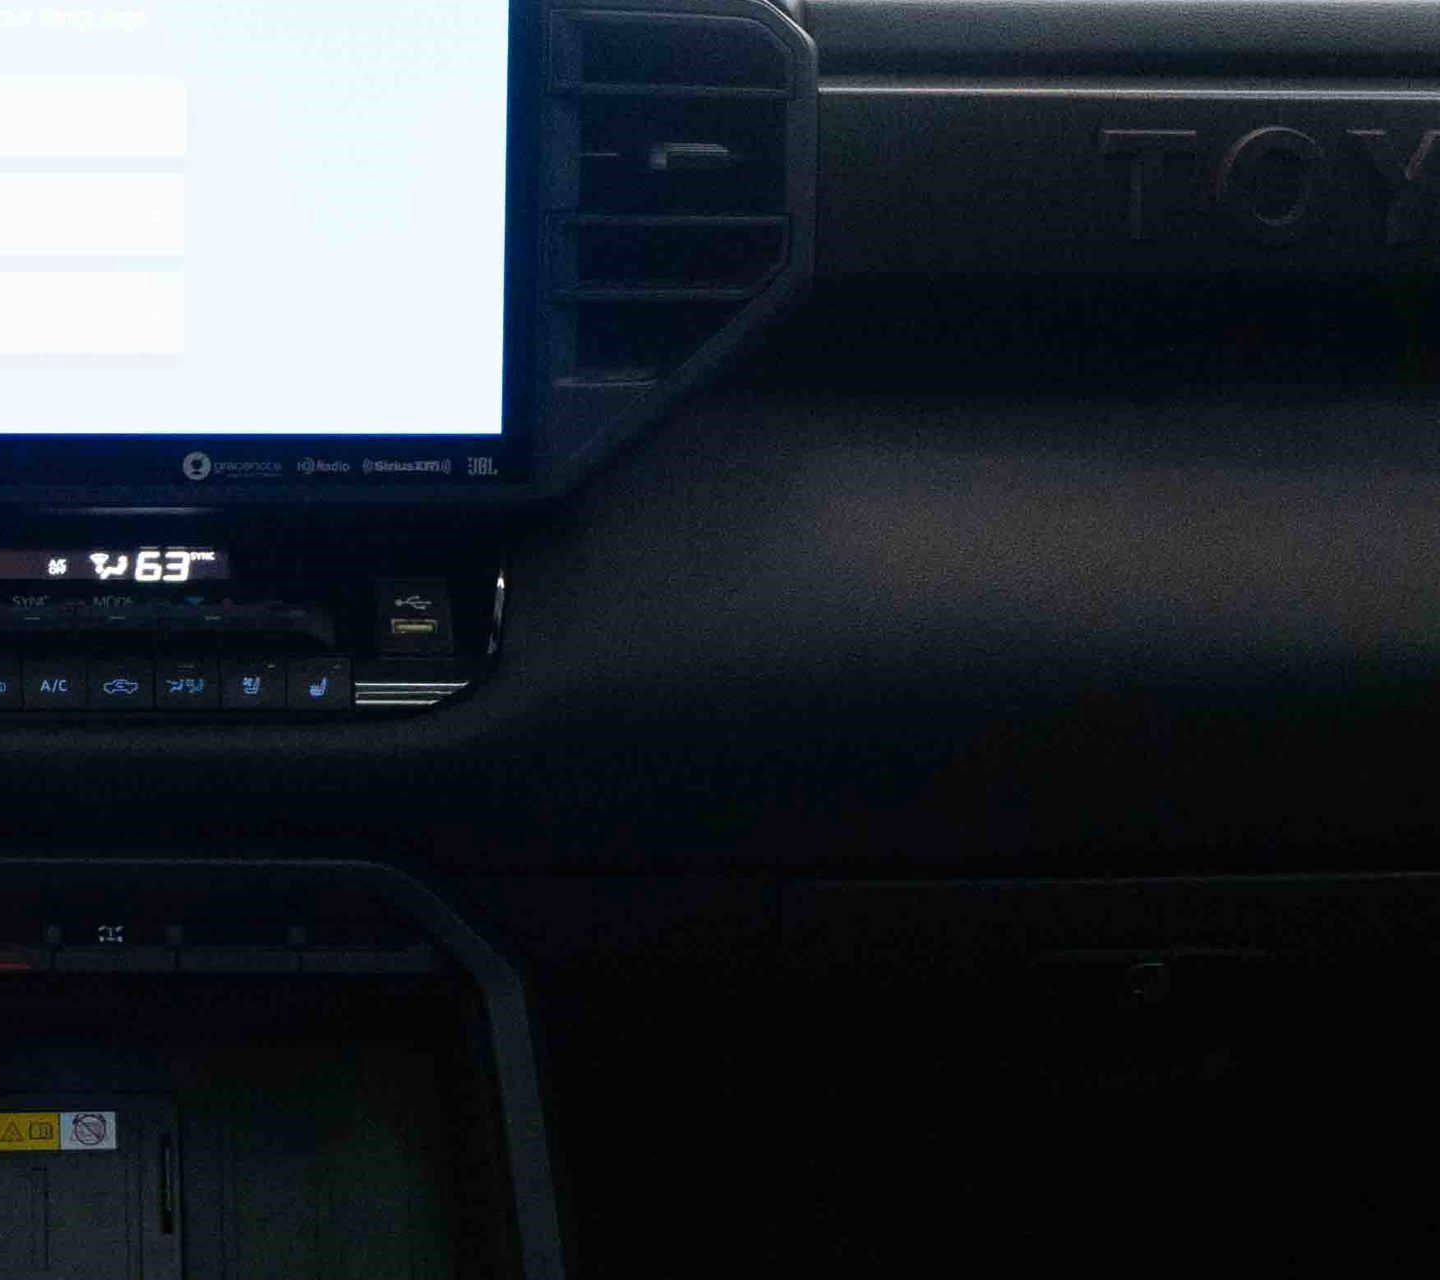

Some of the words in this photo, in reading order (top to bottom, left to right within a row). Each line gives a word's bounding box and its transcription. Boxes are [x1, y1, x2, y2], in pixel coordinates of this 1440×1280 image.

[466, 456, 499, 477] JBL
[134, 549, 190, 583] 63
[39, 678, 68, 694] A/C
